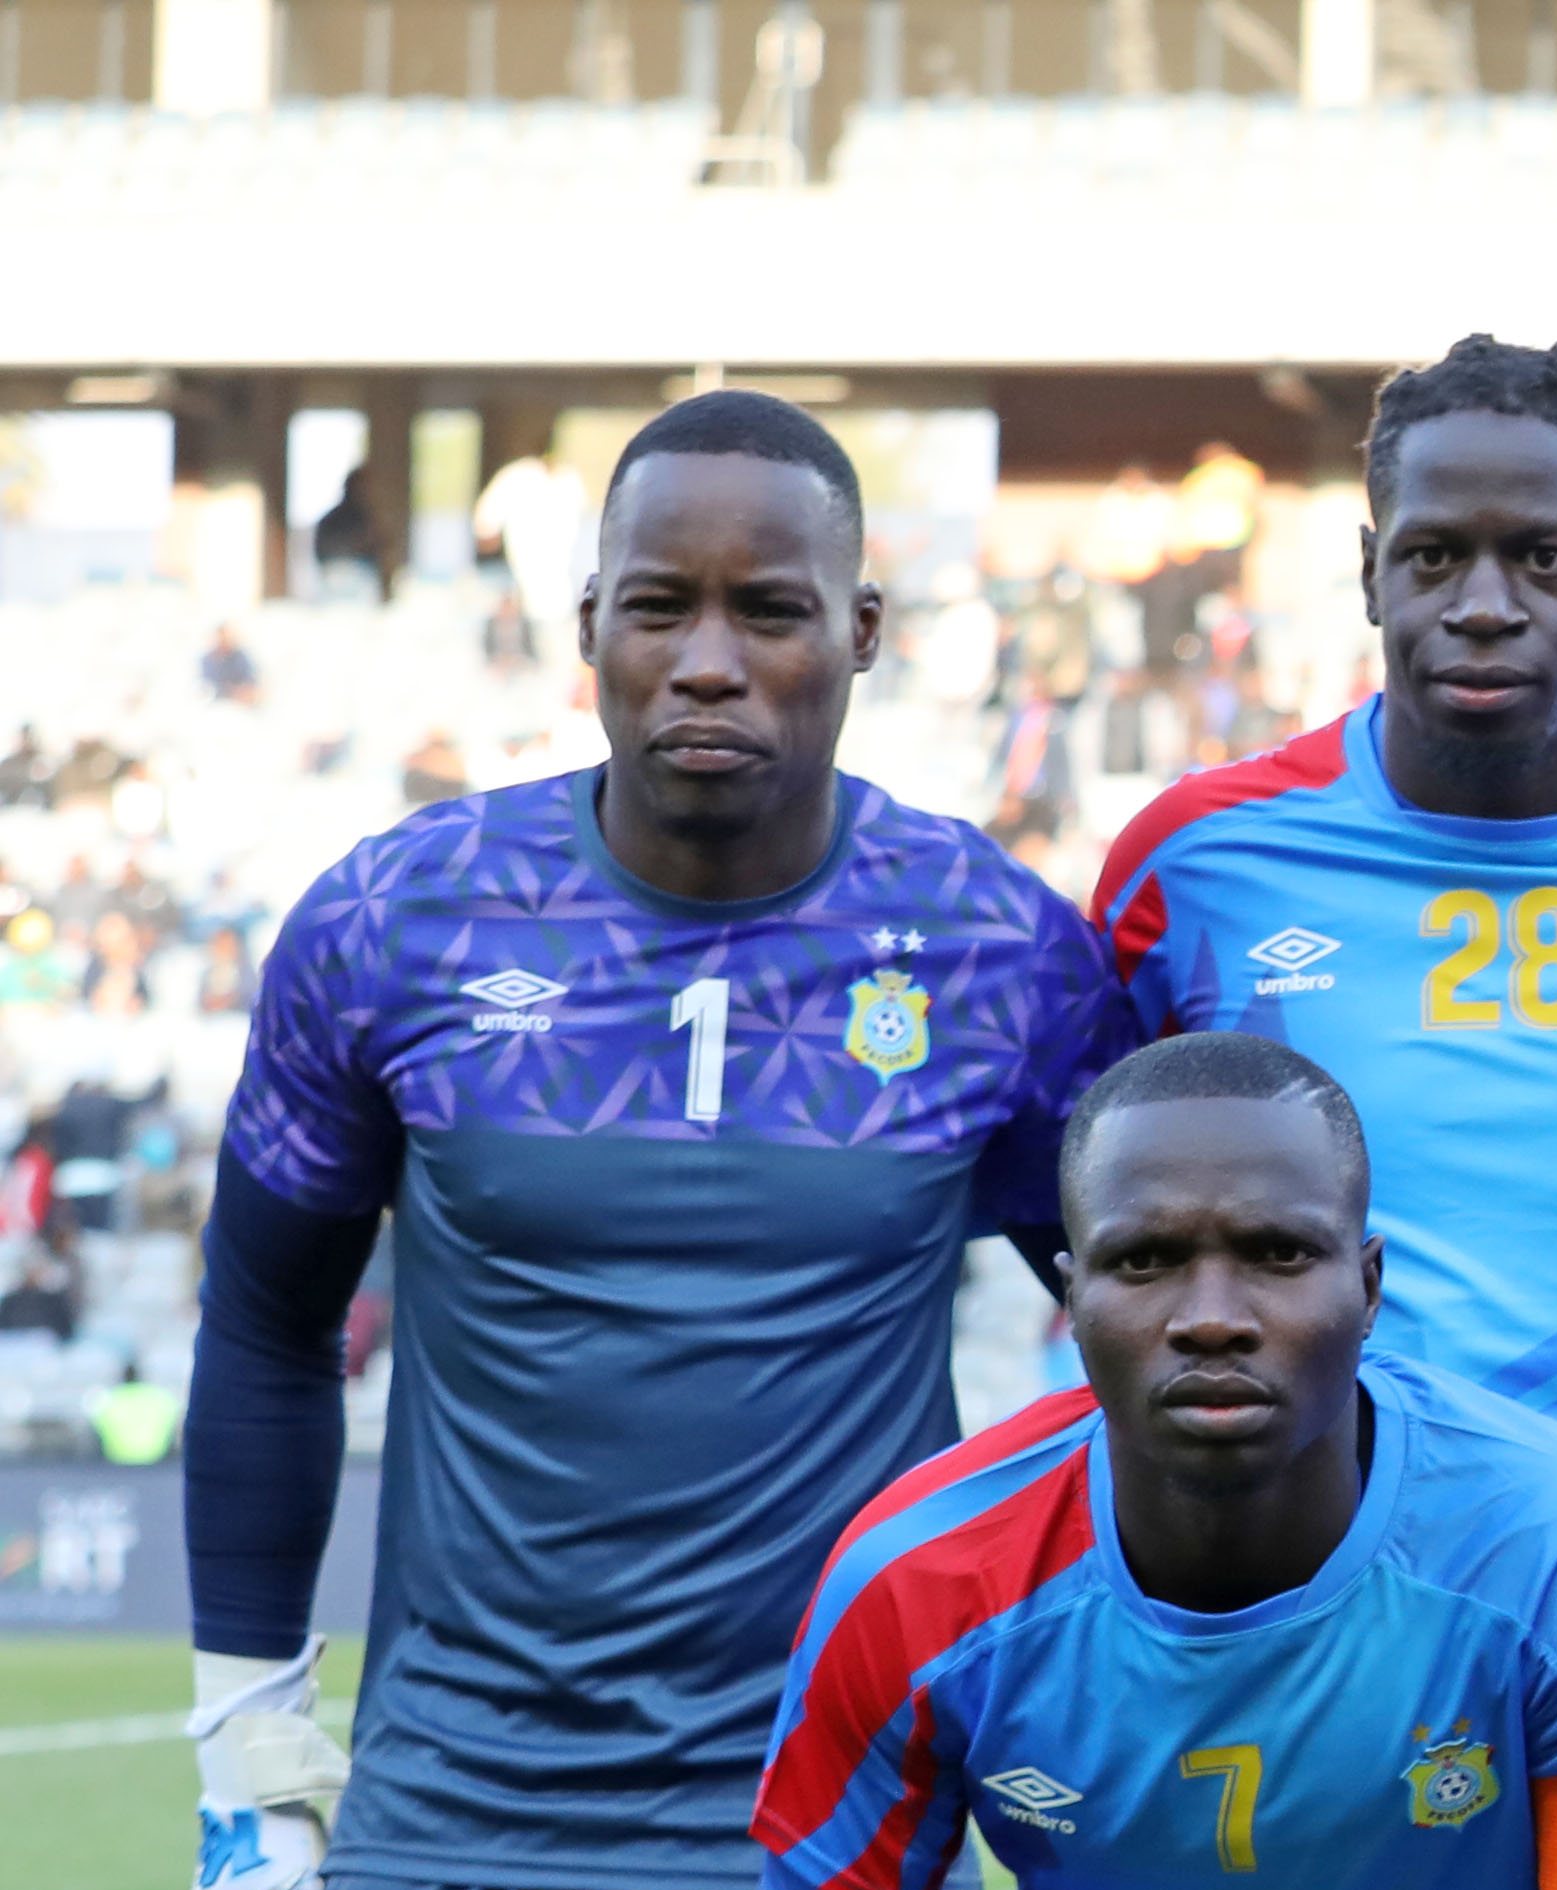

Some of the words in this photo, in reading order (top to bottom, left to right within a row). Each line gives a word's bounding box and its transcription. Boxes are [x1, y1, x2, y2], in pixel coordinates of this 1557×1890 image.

[1255, 972, 1335, 996] umbro
[474, 1012, 552, 1032] umbro
[669, 978, 730, 1122] 1
[1000, 1801, 1077, 1836] umbro
[1179, 1744, 1261, 1872] 7
